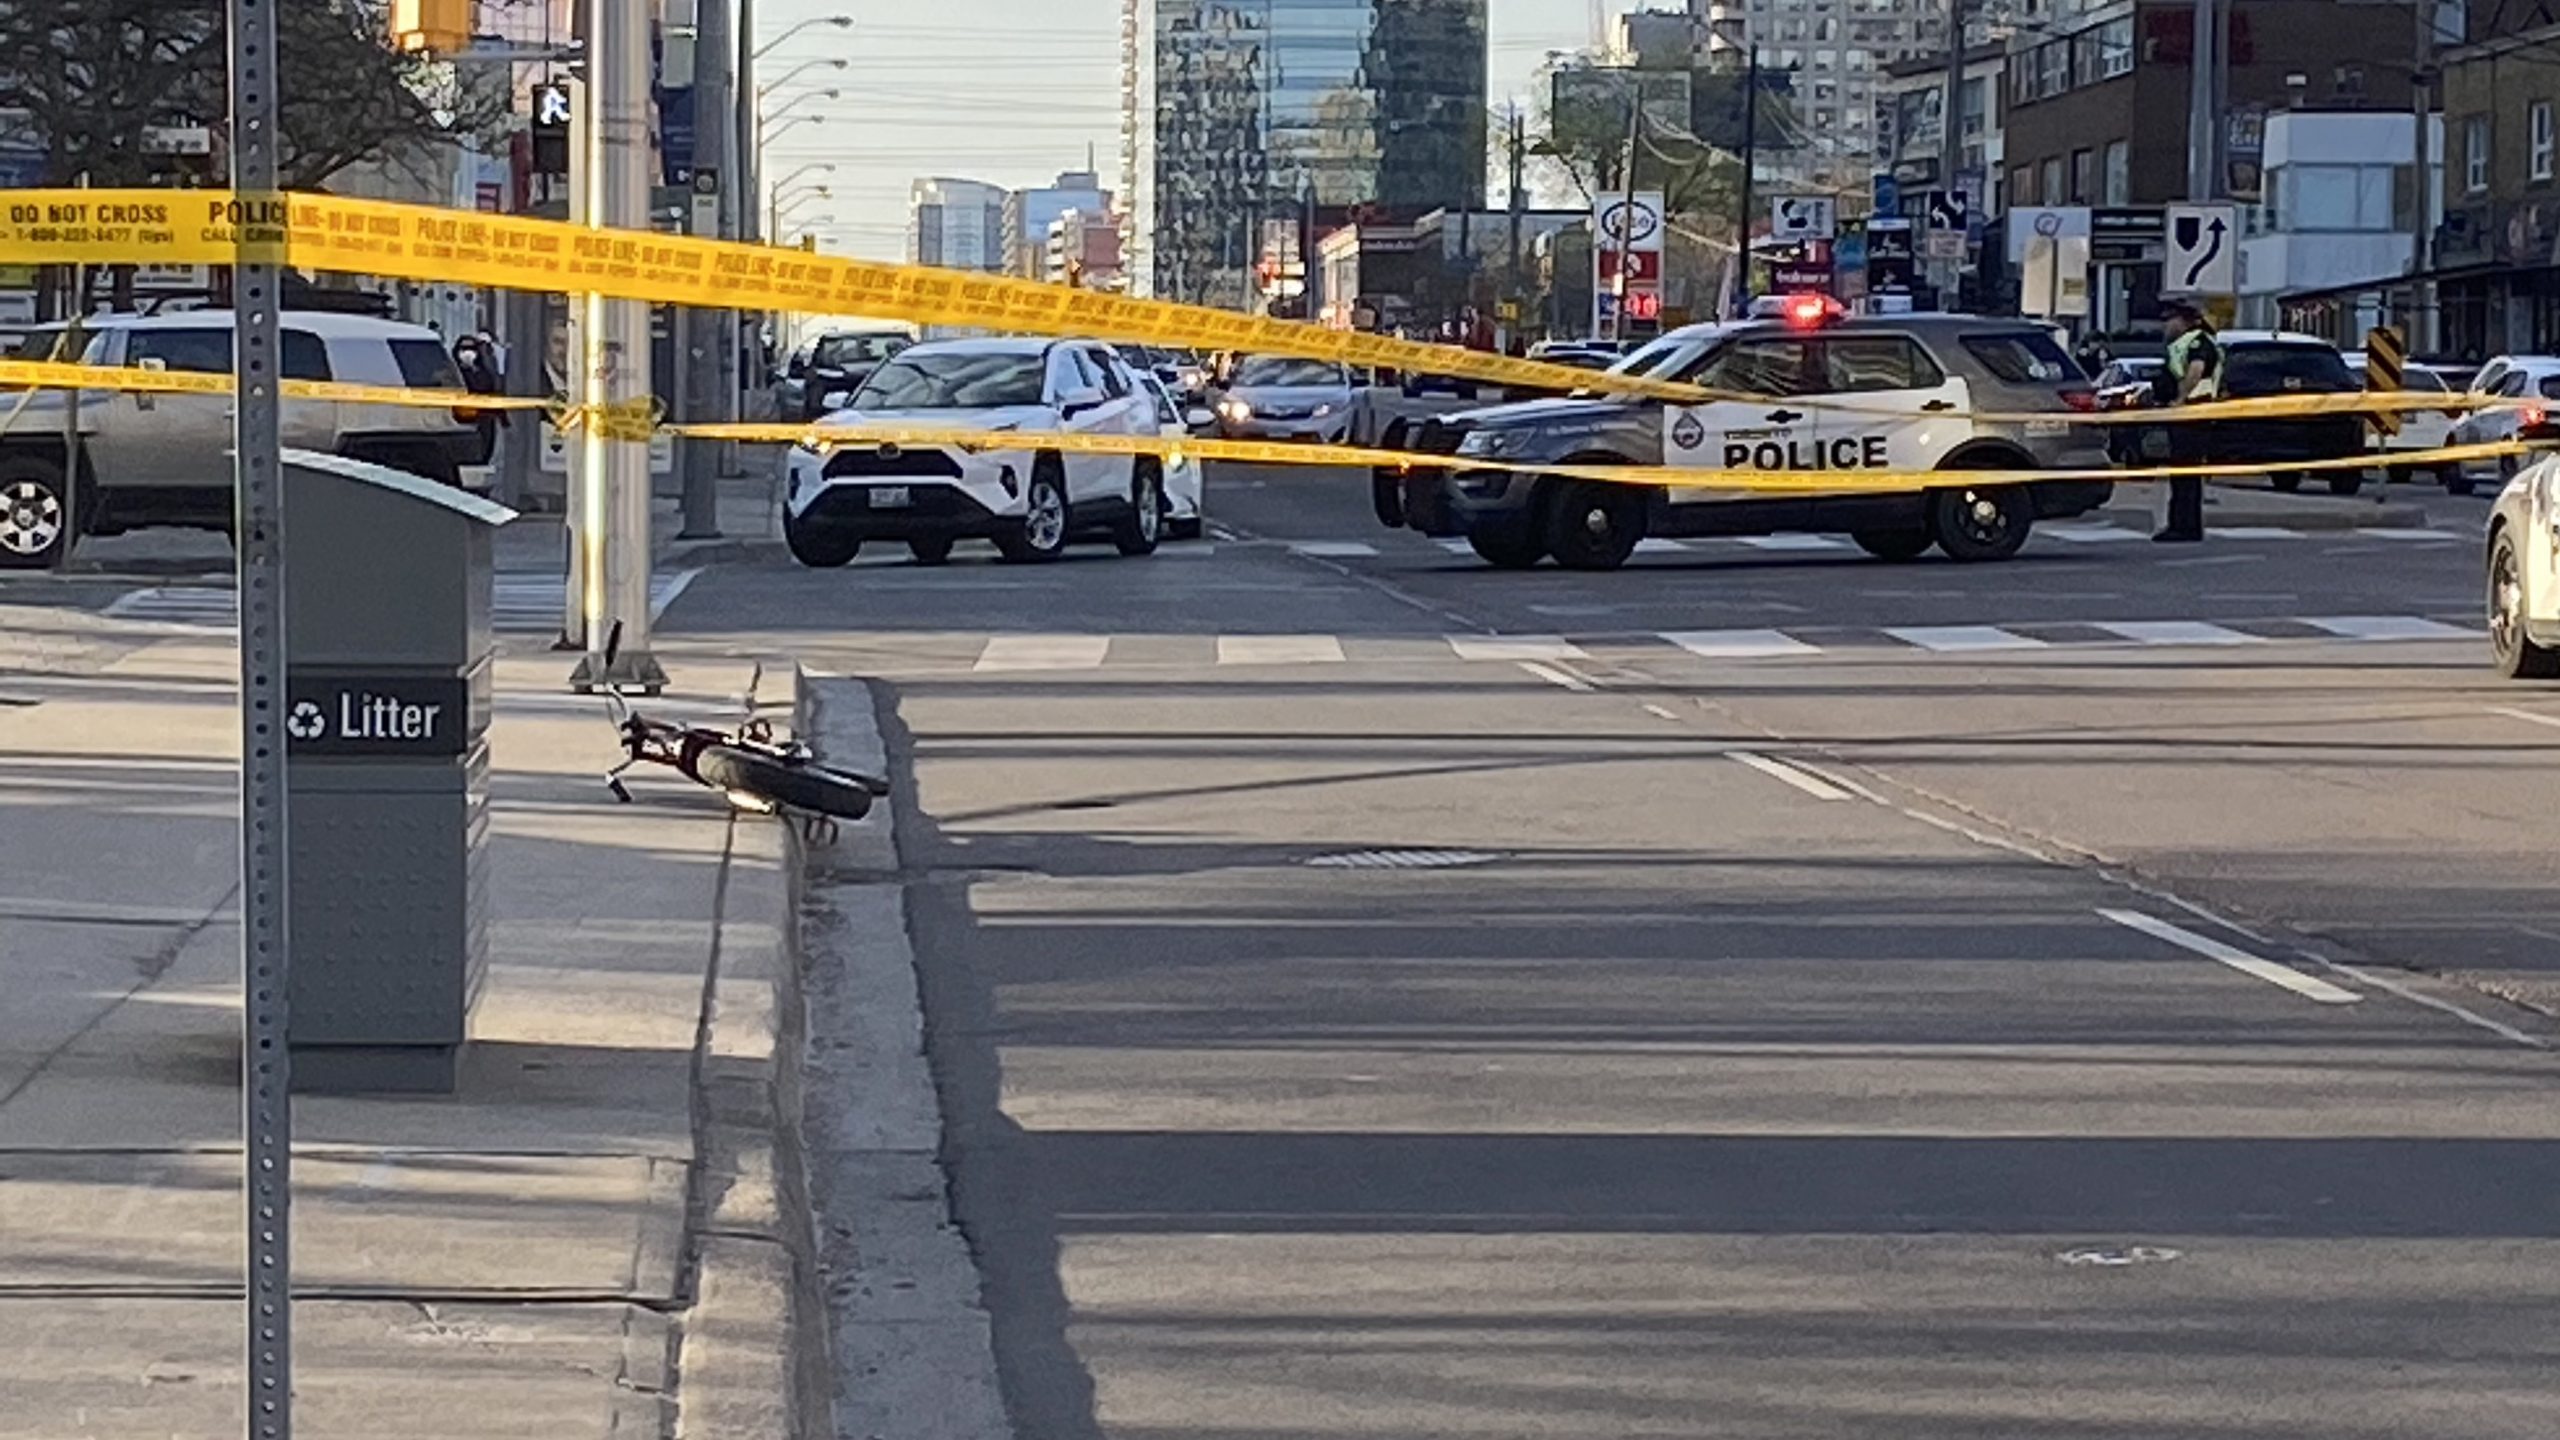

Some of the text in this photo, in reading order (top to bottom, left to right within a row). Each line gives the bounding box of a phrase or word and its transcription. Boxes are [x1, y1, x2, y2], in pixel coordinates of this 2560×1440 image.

[10, 204, 168, 223] DO NOT CROSS
[1724, 436, 1889, 471] POLICE
[340, 691, 440, 738] Litter
